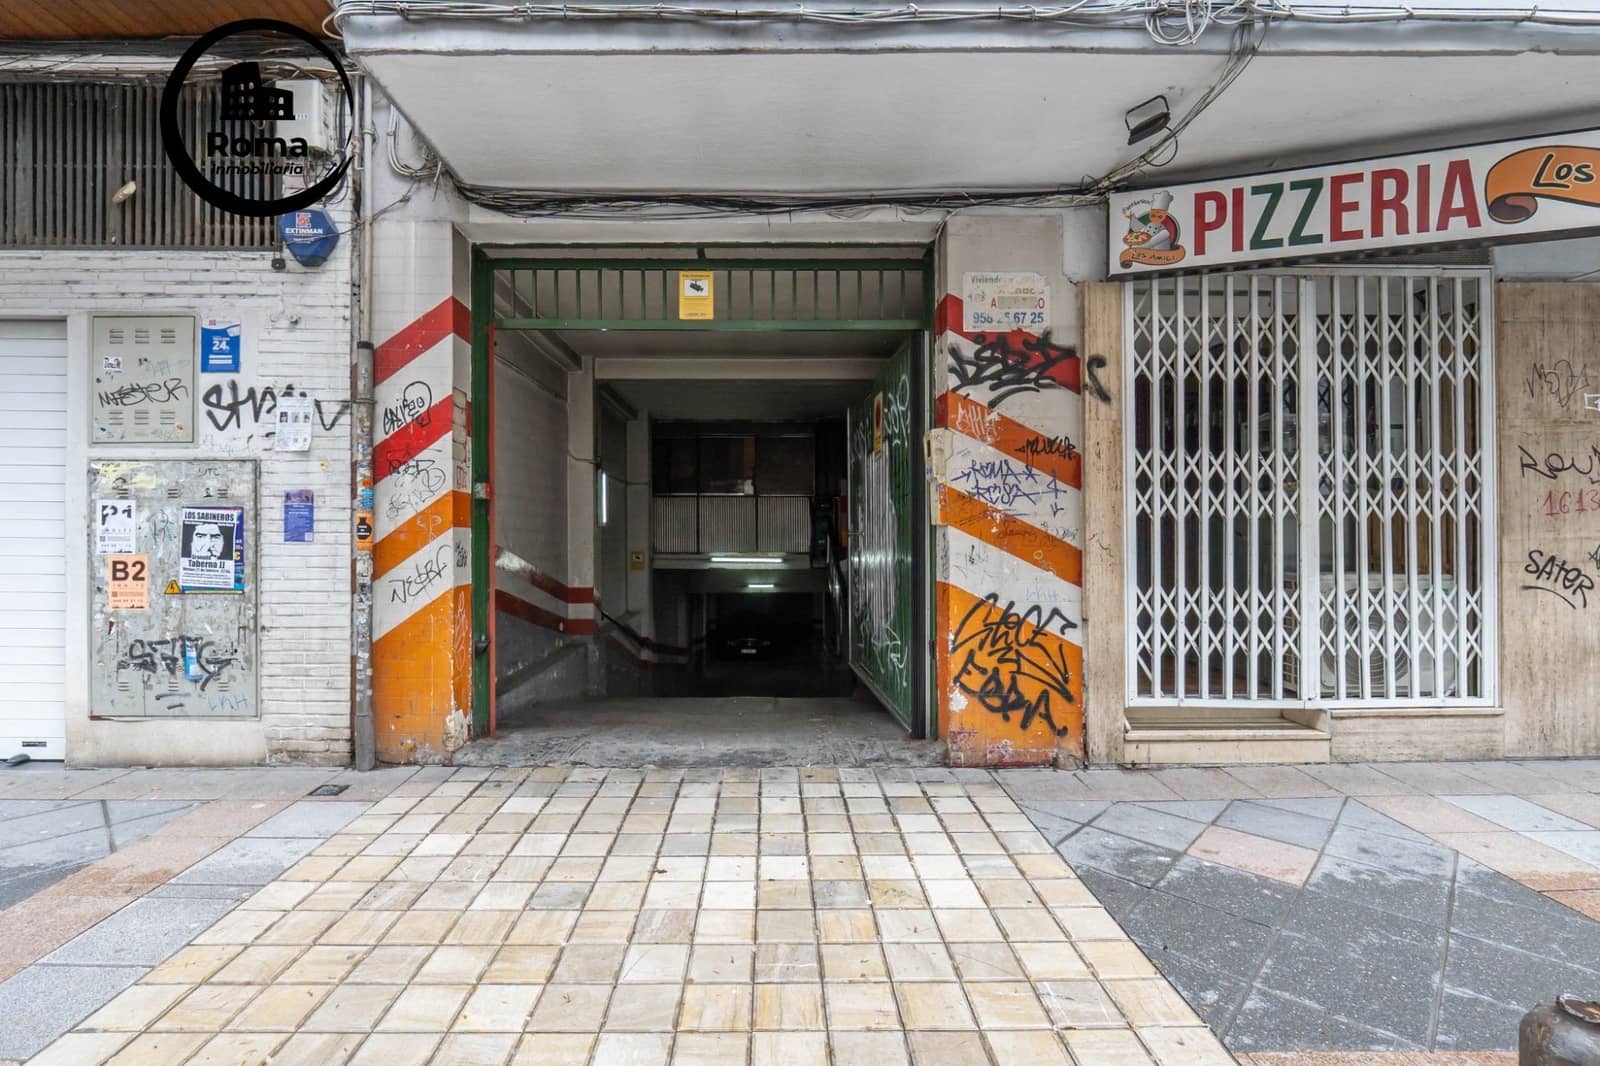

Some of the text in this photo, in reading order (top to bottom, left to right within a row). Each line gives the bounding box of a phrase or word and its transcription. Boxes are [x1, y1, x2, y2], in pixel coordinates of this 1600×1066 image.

[1531, 152, 1596, 190] Los
[1193, 158, 1482, 257] PIZZERIA
[1013, 311, 1027, 324] 67
[1030, 311, 1045, 324] 25
[184, 511, 234, 522] LOS SABINEROS
[112, 560, 145, 581] B2
[188, 559, 218, 568] Taberna
